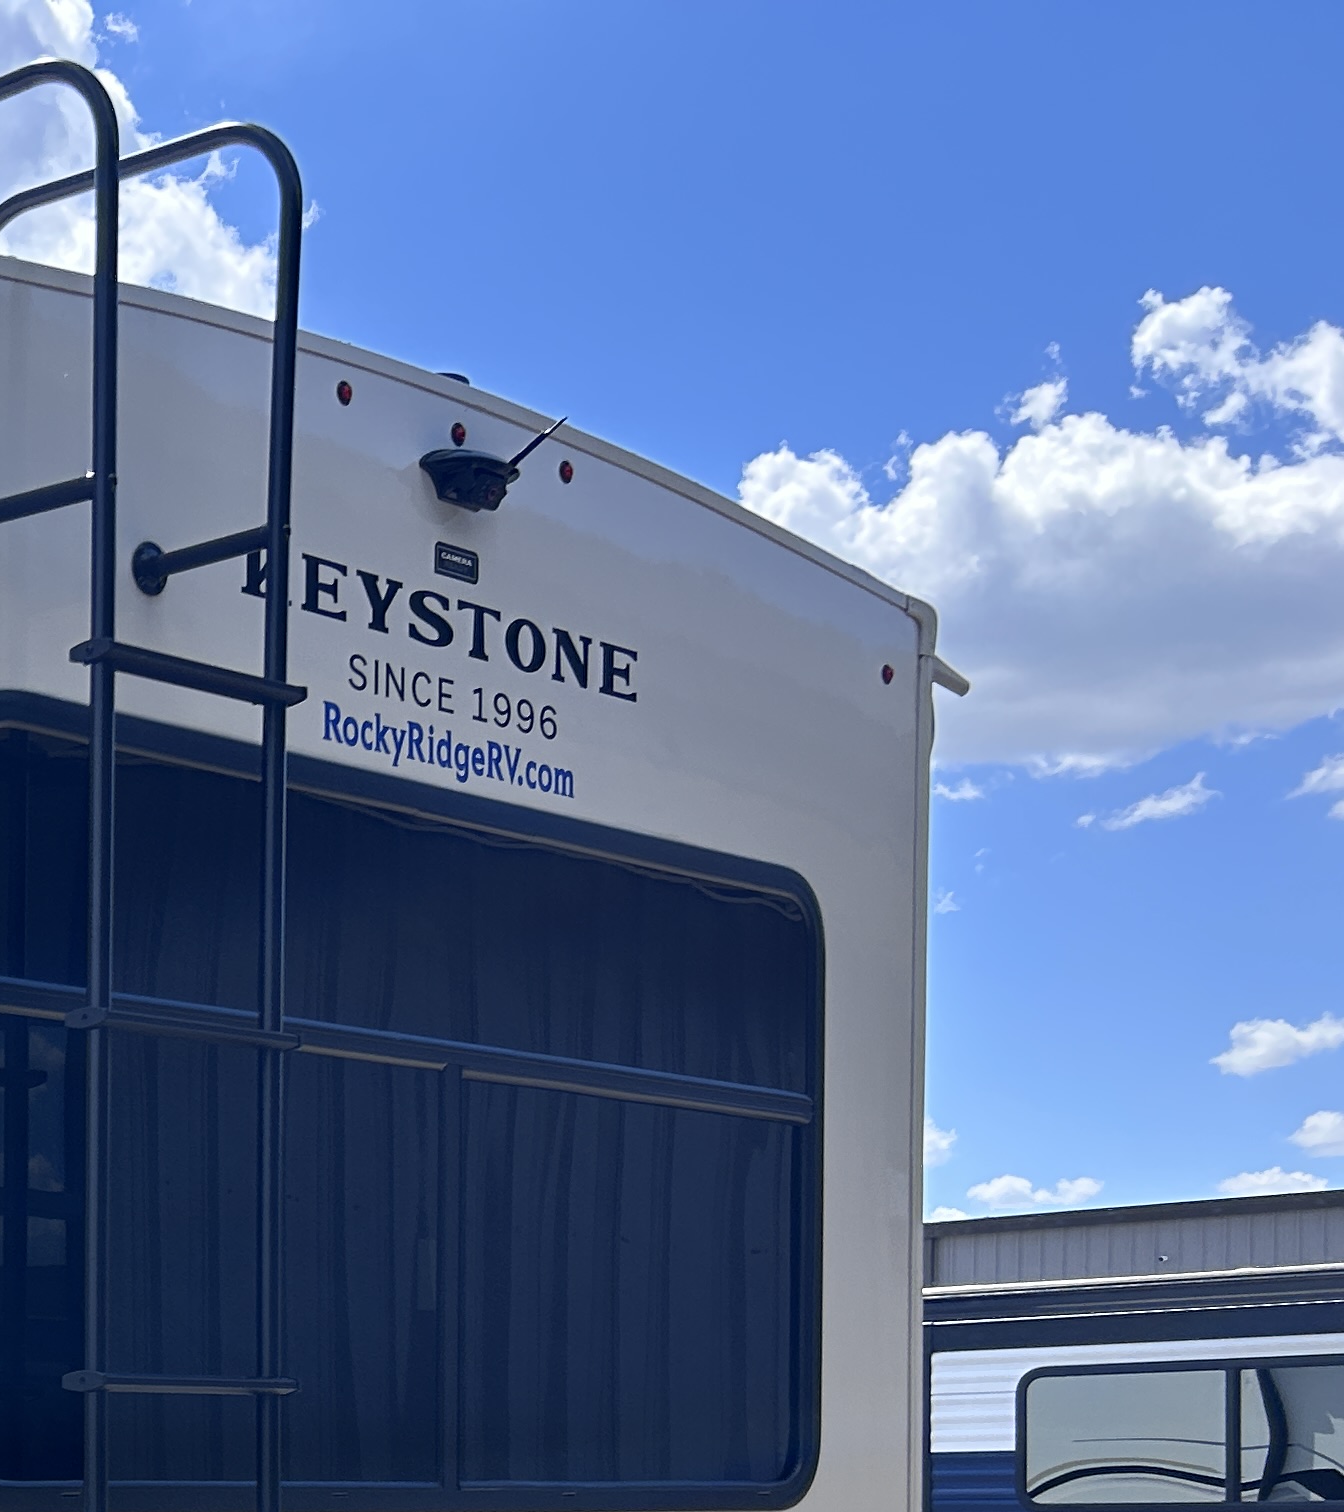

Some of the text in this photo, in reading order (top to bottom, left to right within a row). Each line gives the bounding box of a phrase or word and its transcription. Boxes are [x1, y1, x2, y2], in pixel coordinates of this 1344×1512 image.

[348, 653, 558, 740] SINCE 1996
[322, 700, 575, 799] RockyRidgeRV.com
